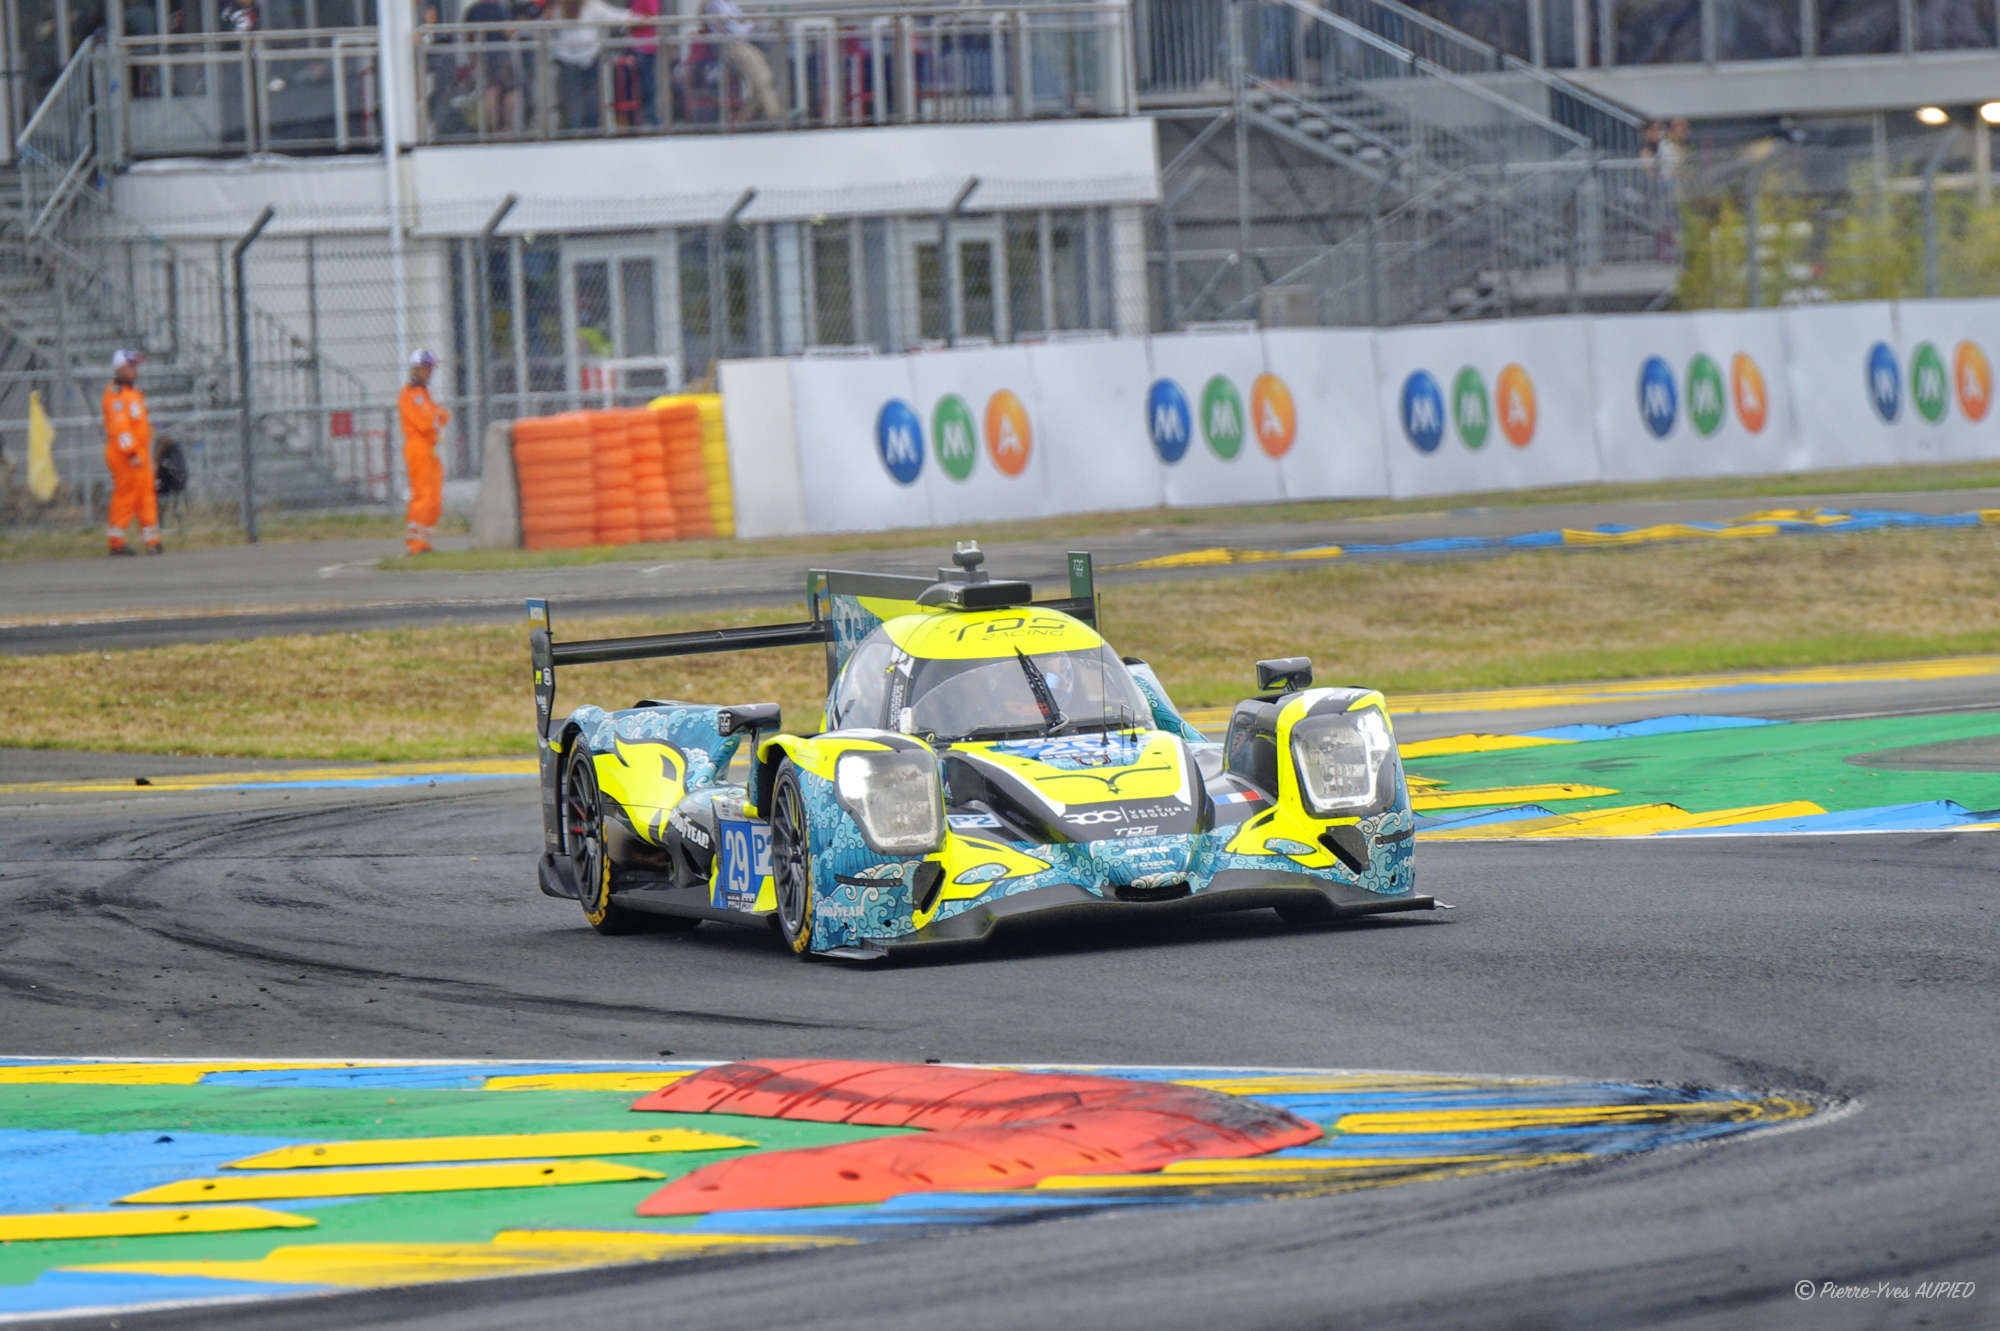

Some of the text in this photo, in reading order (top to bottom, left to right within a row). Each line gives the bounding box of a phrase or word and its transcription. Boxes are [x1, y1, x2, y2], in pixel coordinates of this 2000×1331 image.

[949, 816, 997, 826] P2
[1113, 825, 1160, 837] TDS
[725, 829, 750, 892] 29
